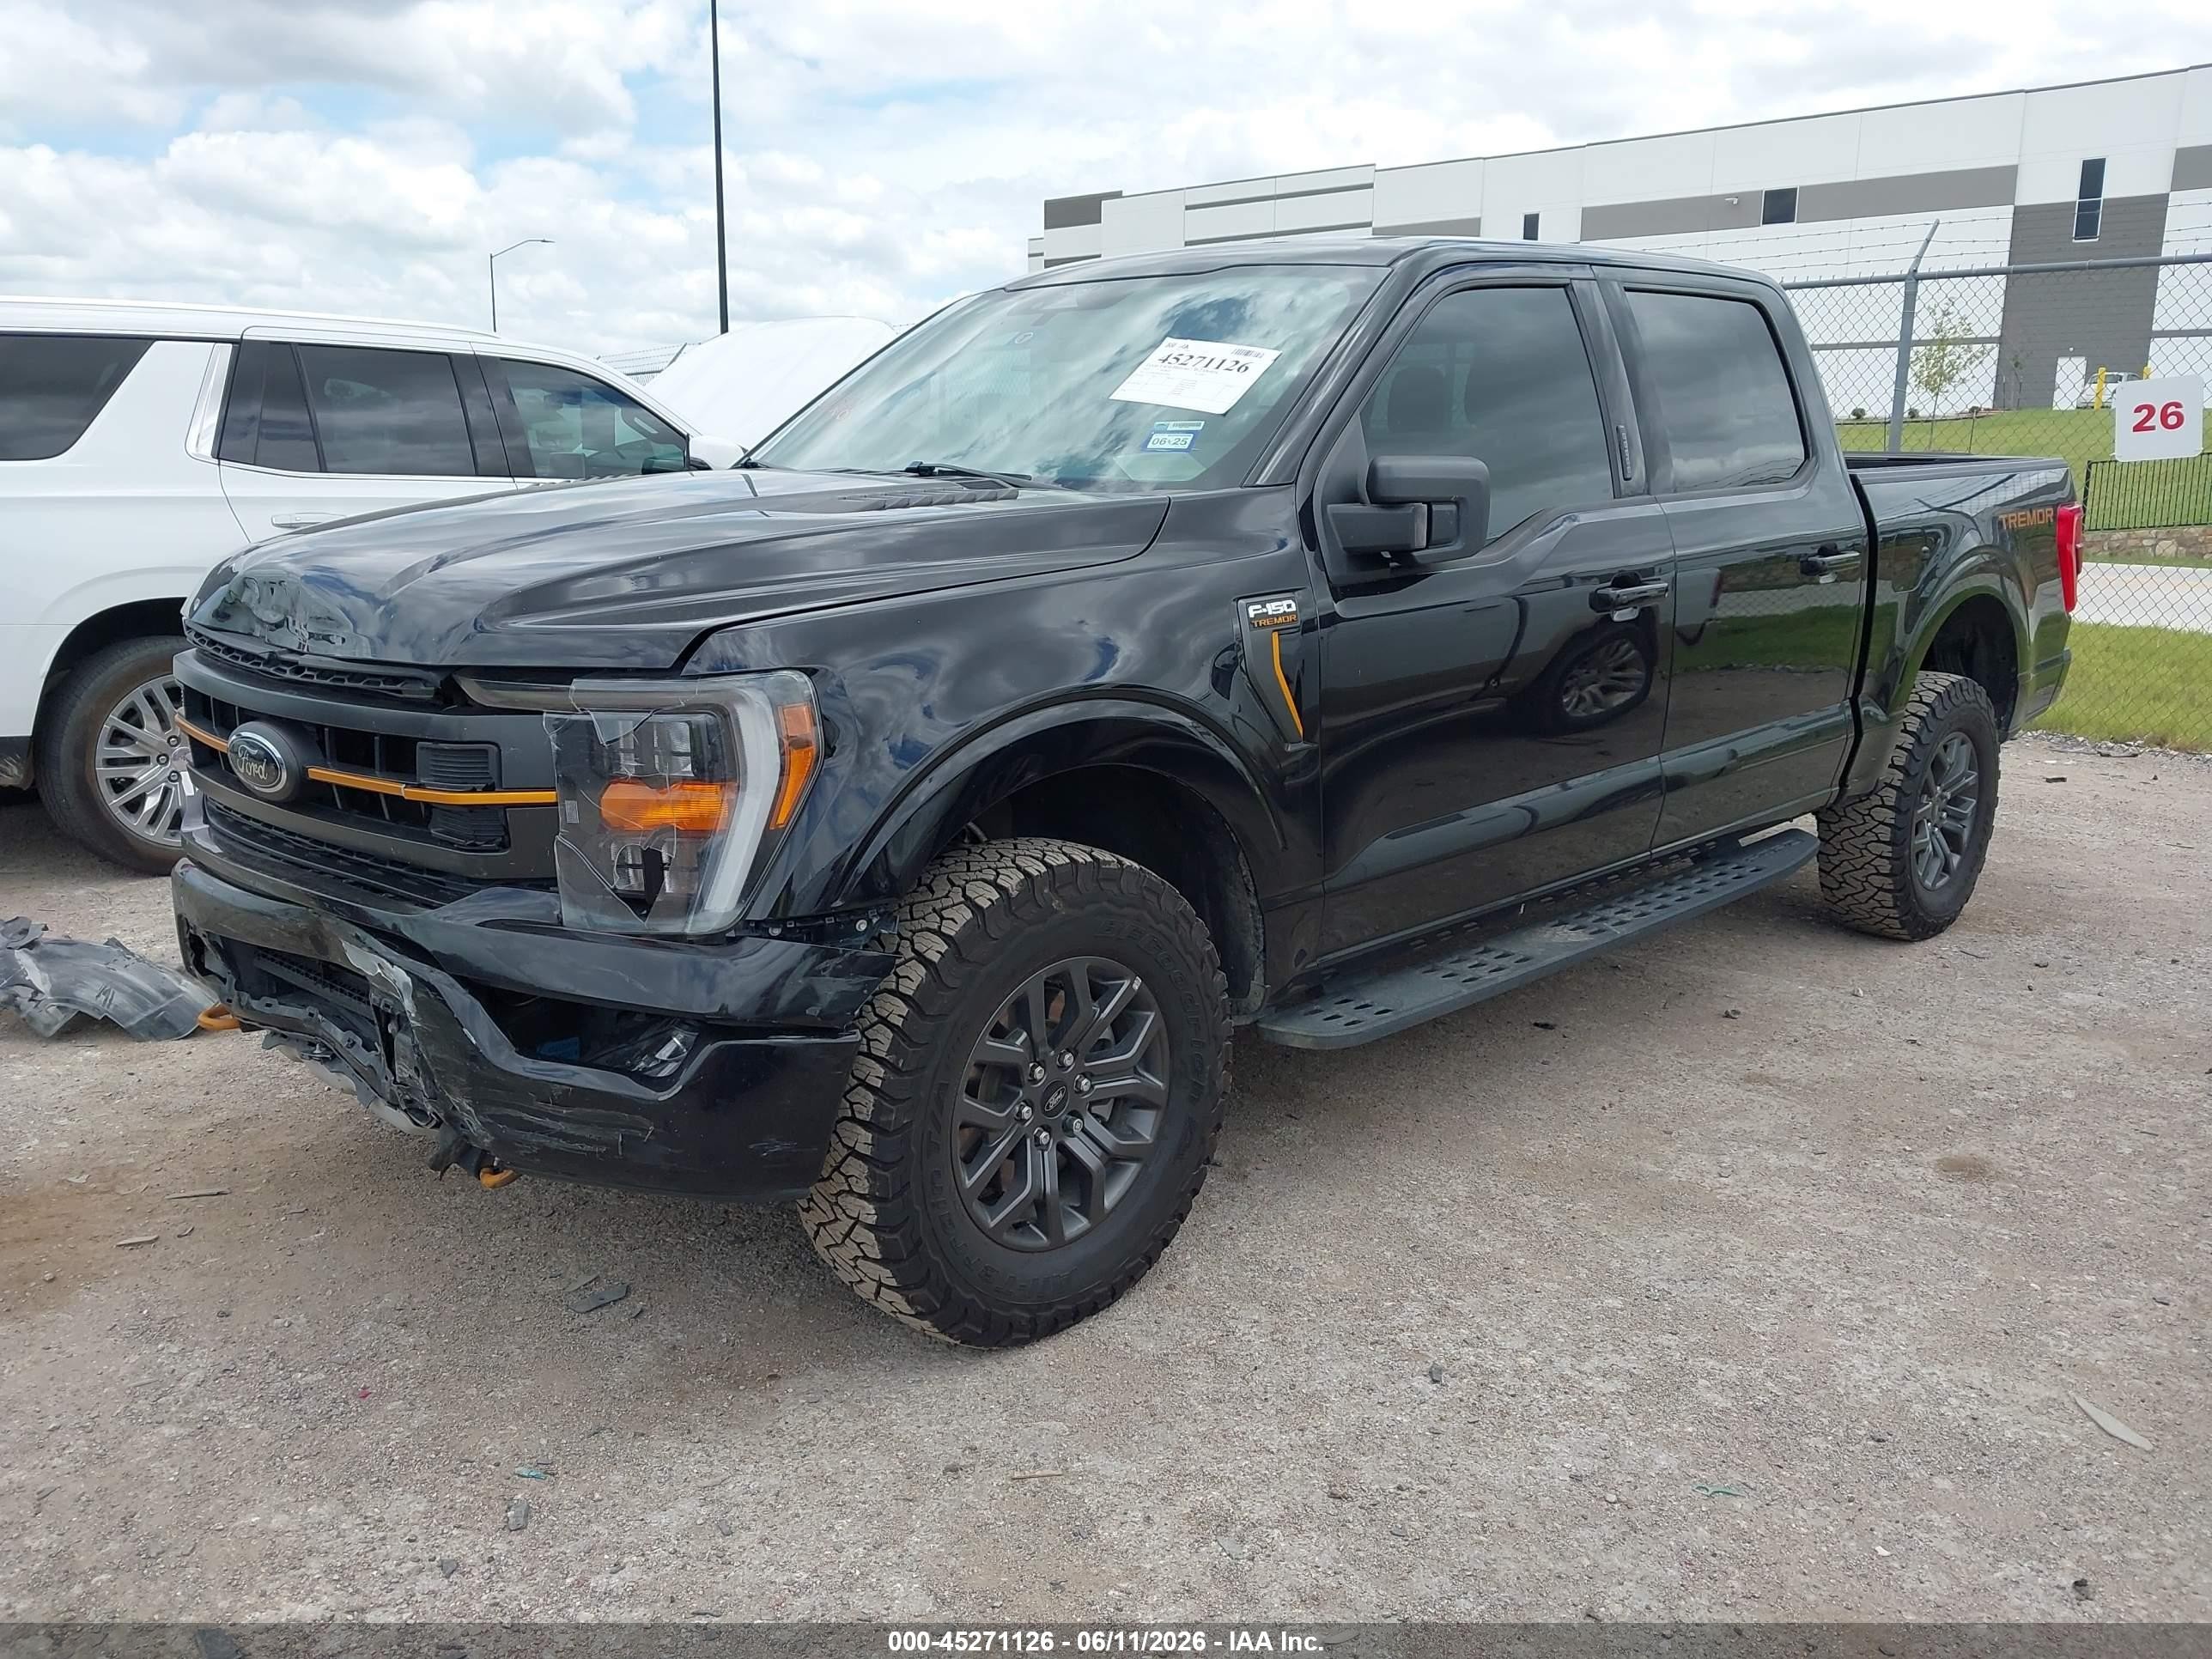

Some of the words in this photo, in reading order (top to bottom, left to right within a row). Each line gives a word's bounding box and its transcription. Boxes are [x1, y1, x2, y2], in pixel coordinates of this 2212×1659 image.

[1158, 352, 1255, 374] 45271126
[2131, 400, 2185, 433] 26
[1152, 437, 1168, 446] 06
[1172, 437, 1189, 446] 25
[1998, 507, 2054, 530] TREMOR
[1248, 599, 1297, 618] F-150
[1251, 614, 1297, 628] TREMOR
[236, 744, 269, 781] Ford
